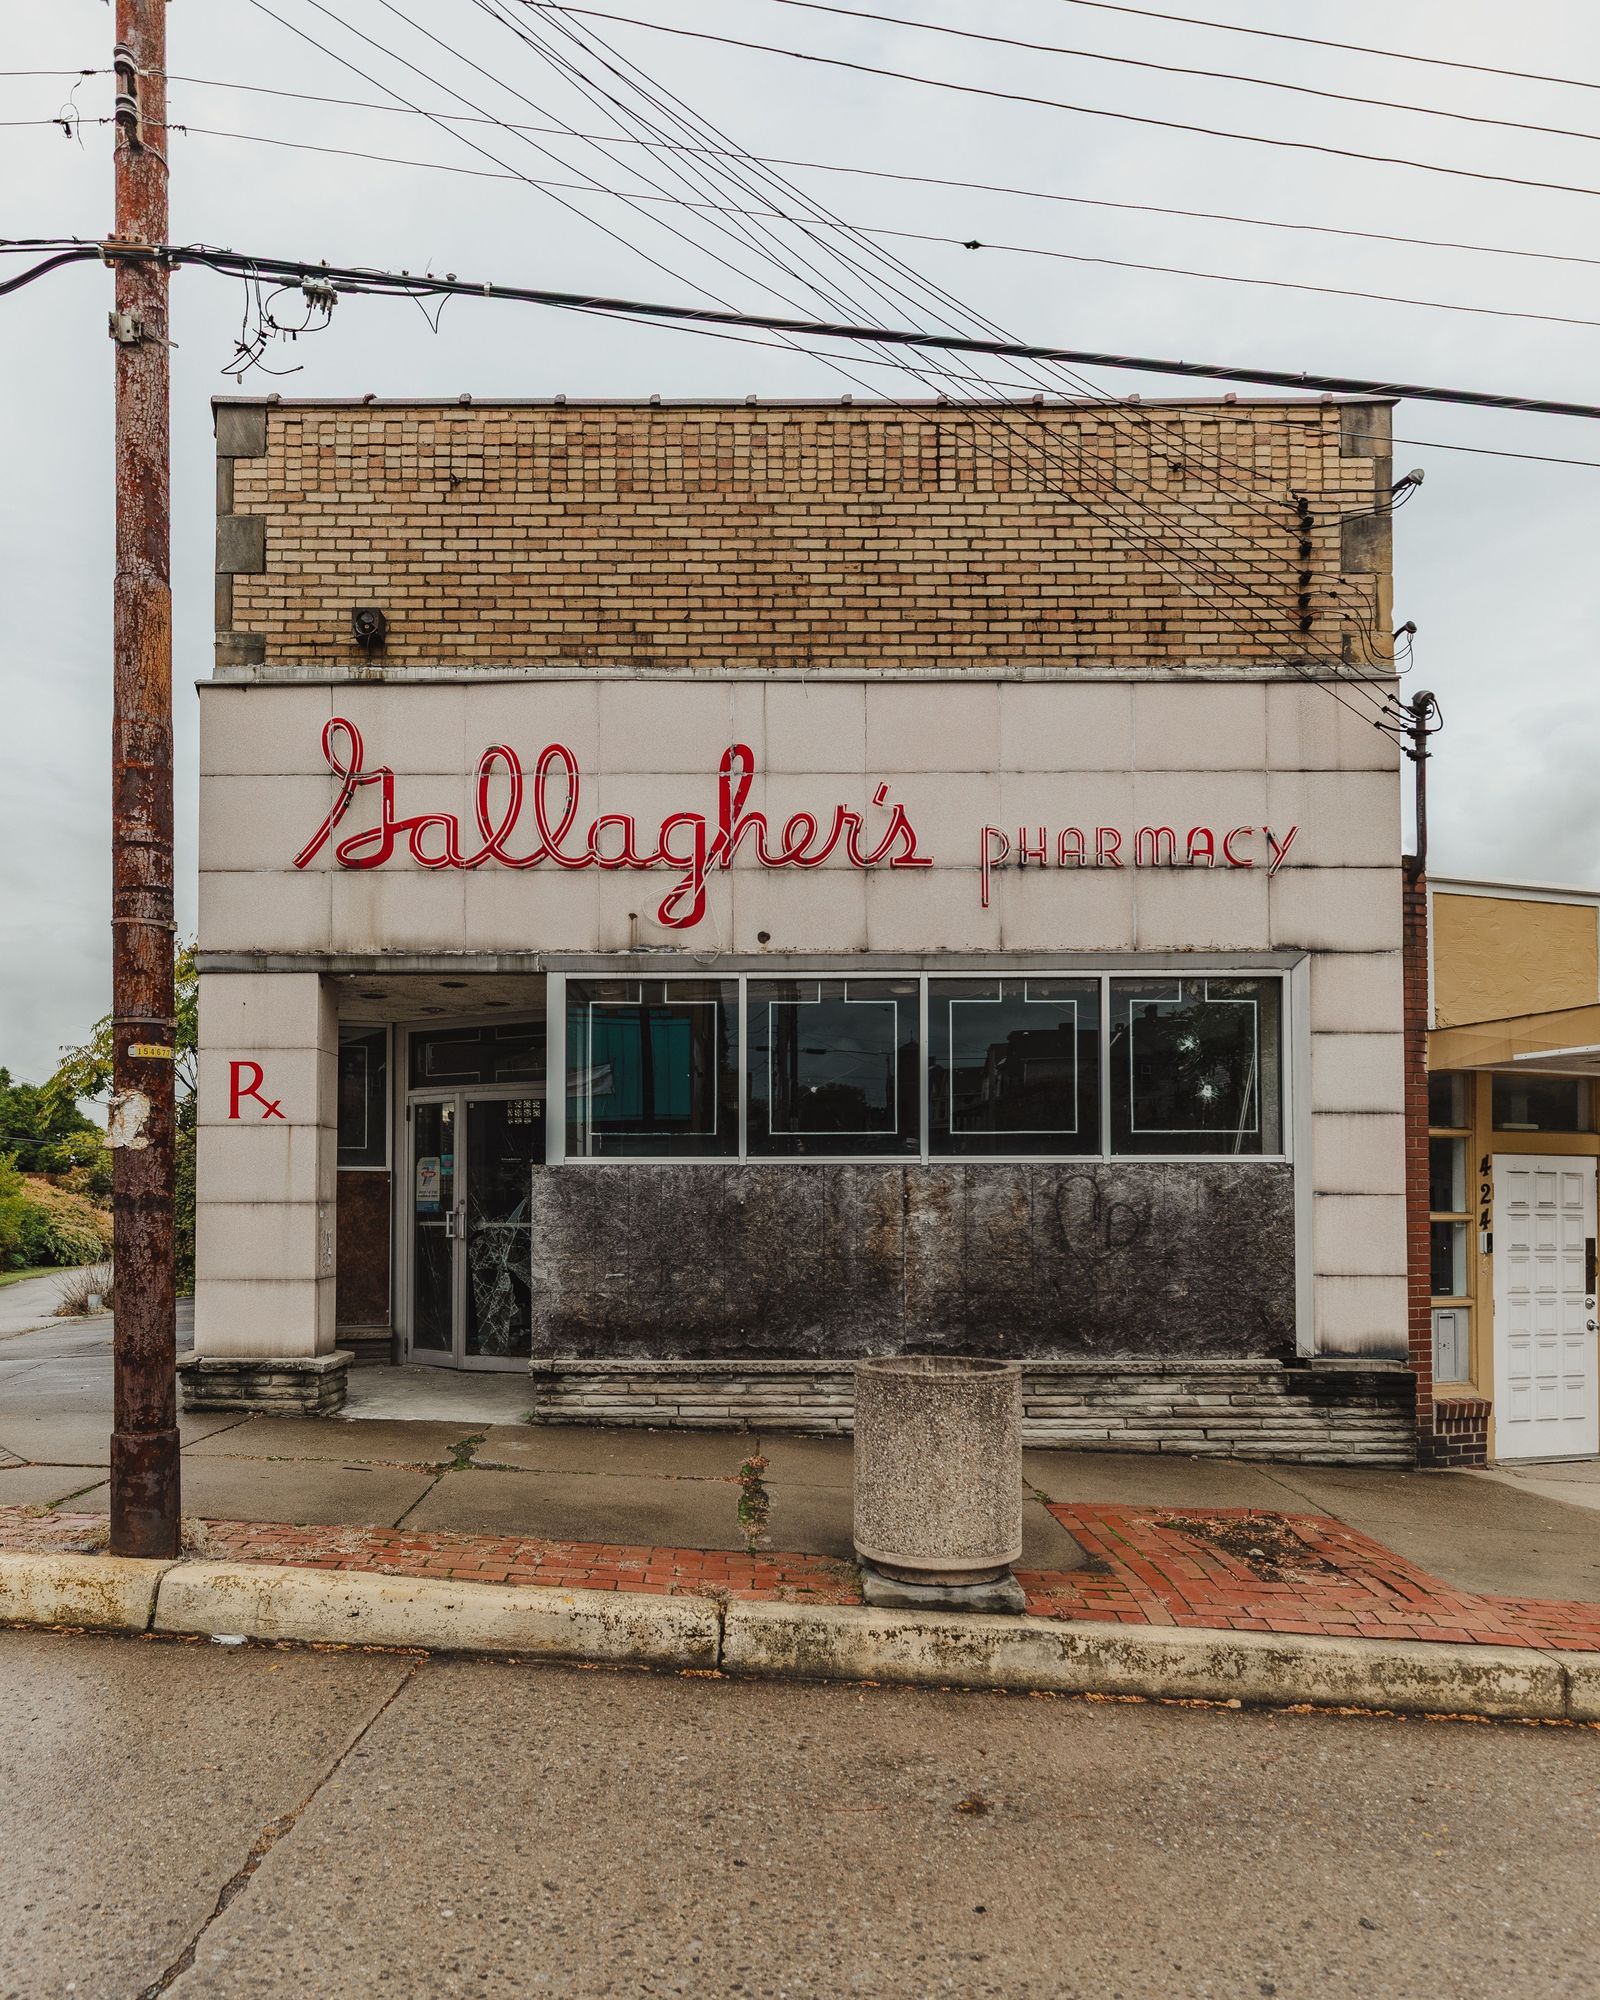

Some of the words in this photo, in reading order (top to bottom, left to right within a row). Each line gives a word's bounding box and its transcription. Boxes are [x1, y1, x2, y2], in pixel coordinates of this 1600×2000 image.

[293, 716, 934, 928] Gallagher's
[981, 824, 1300, 908] PHARMACY
[228, 1061, 287, 1119] Rx
[1479, 1154, 1492, 1230] 424
